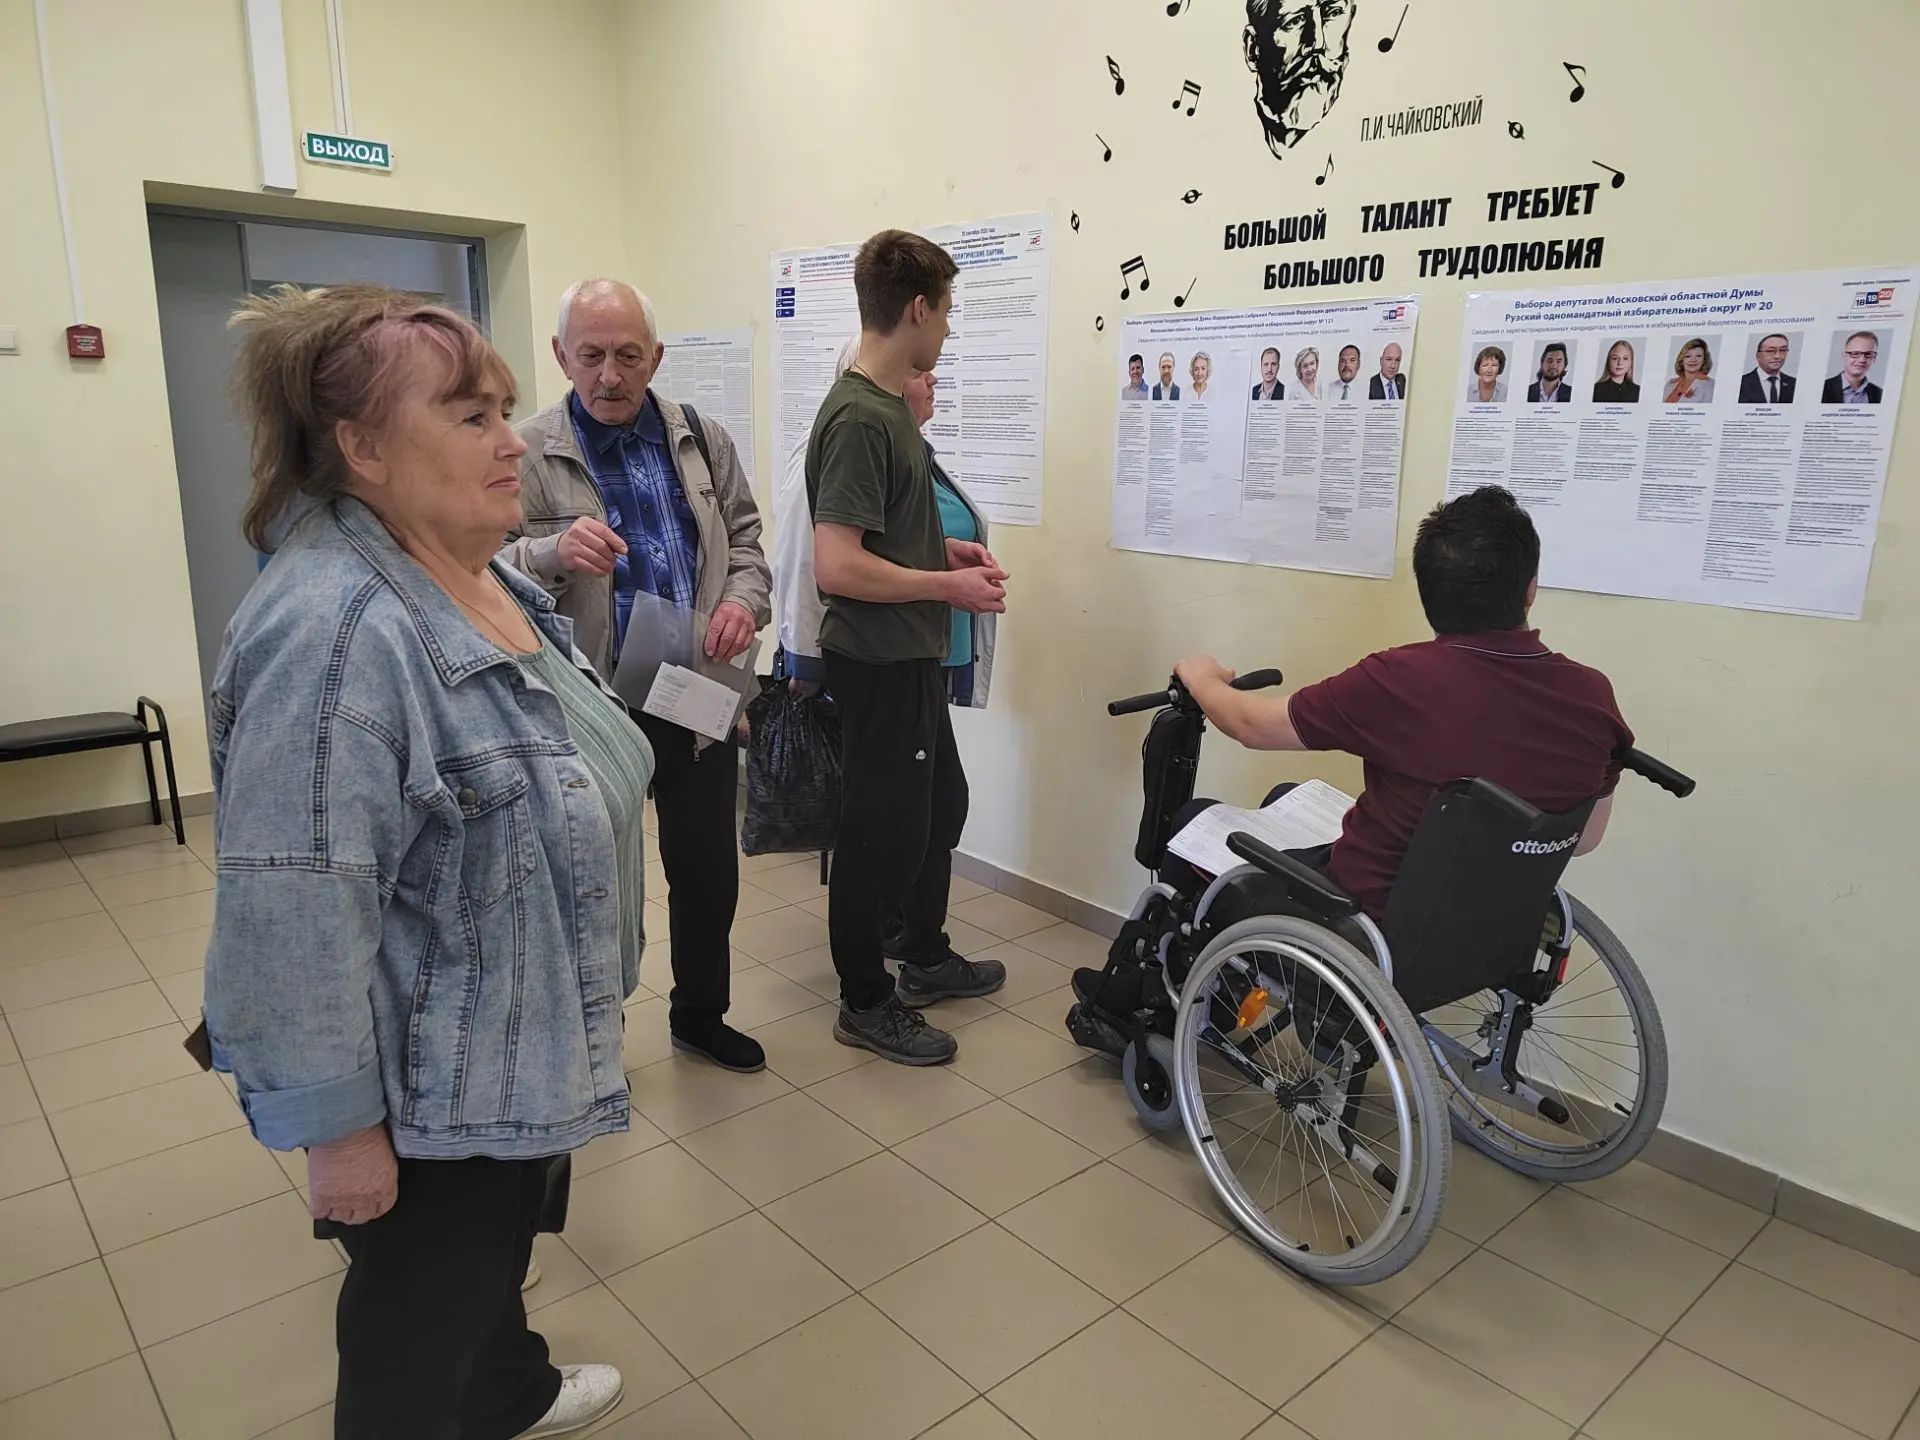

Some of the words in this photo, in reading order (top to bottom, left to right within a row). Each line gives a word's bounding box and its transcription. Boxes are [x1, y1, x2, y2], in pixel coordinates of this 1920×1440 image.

[312, 138, 385, 164] ВЫХОД
[1224, 208, 1327, 251] БОЛЬШОЙ
[1360, 197, 1453, 234] ТАЛАНТ
[1486, 183, 1600, 222] ТРЕБУЕТ
[1263, 253, 1385, 290] БОЛЬШОГО
[1417, 237, 1604, 280] ТРУДОЛЮБИЯ
[1514, 300, 1553, 309] Выборы
[1554, 298, 1604, 308] депутатов
[1605, 292, 1668, 304] Московской
[1669, 289, 1728, 302] областной
[1729, 288, 1764, 300] Думы
[1867, 294, 1877, 302] 19
[1505, 313, 1542, 324] Рузский
[1543, 309, 1622, 321] одномандатный
[1624, 304, 1708, 317] избирательный
[1709, 304, 1742, 315] округ
[1744, 302, 1757, 312] №
[1758, 301, 1773, 311] 20
